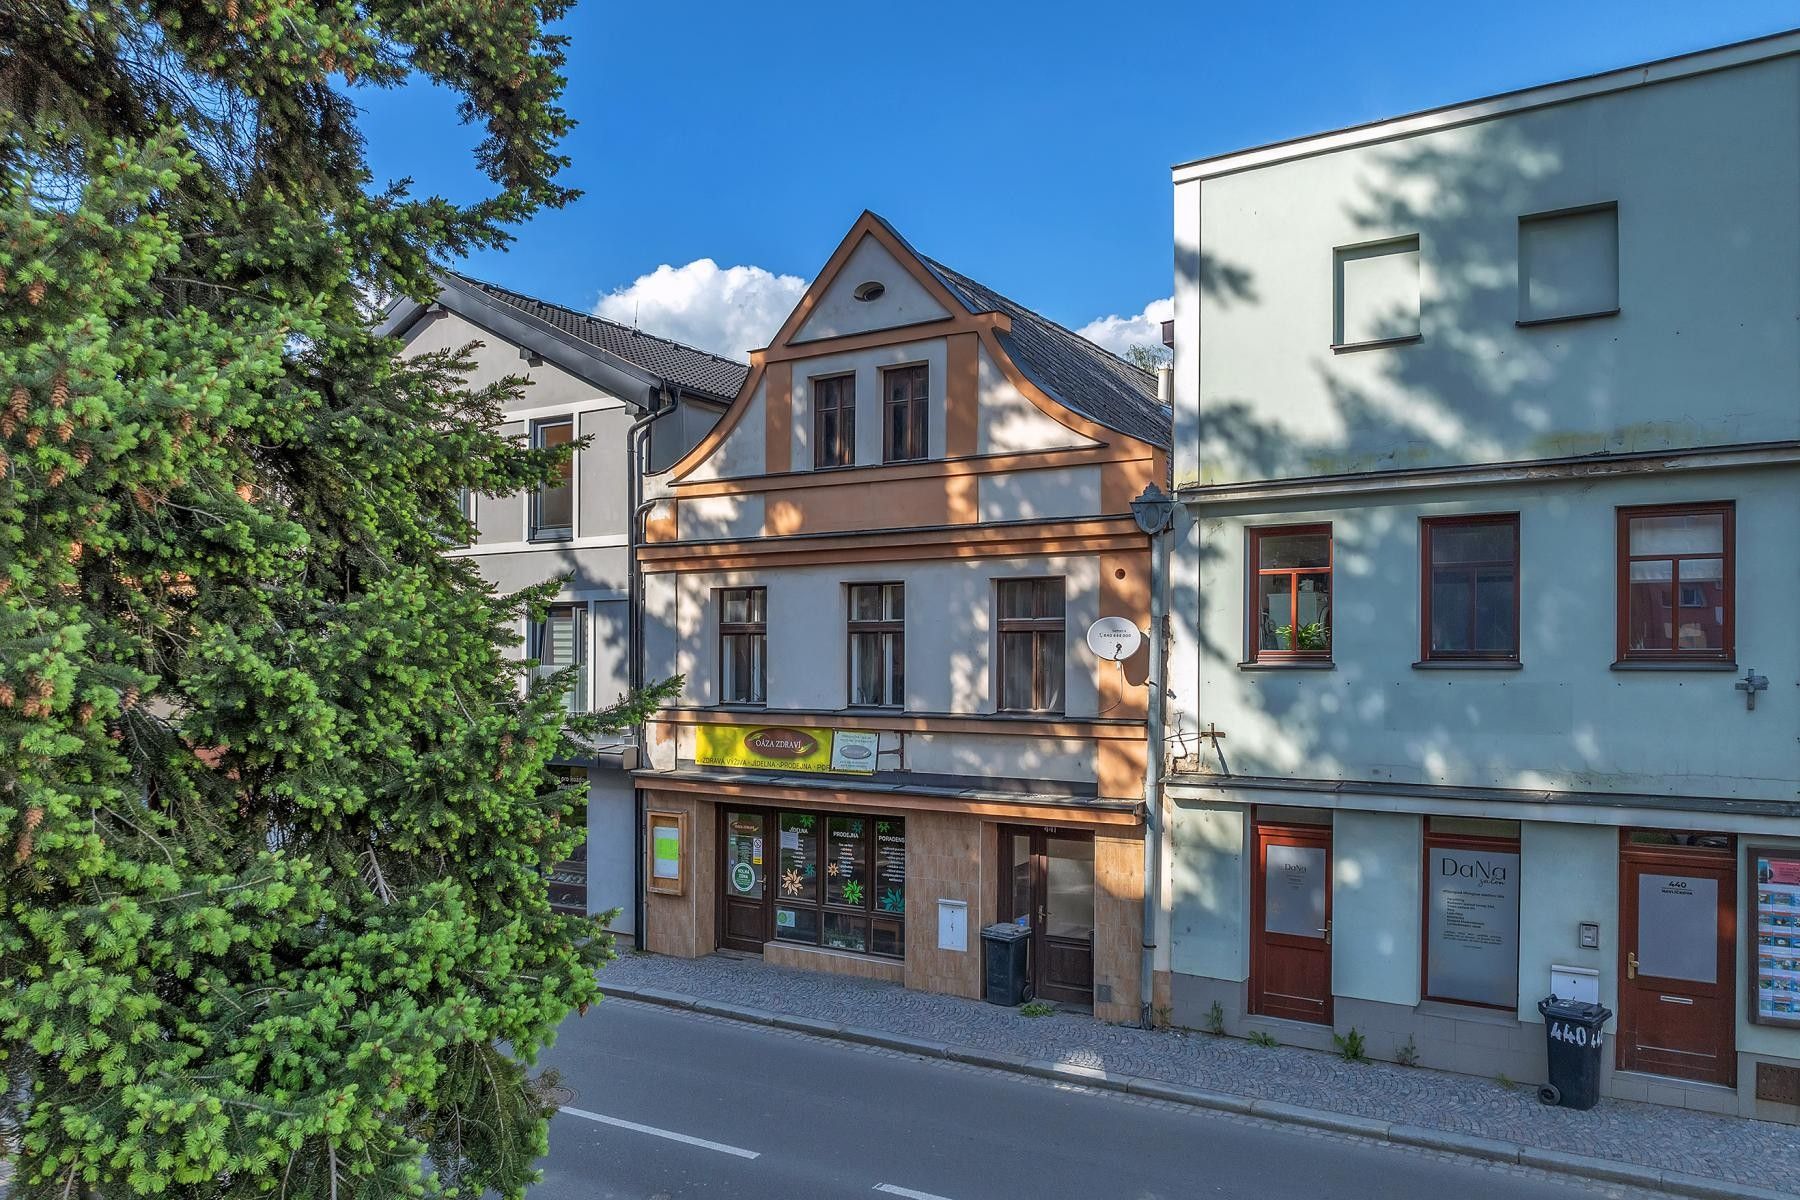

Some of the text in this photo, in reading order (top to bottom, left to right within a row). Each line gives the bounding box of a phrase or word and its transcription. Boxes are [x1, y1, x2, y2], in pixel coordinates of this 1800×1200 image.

[755, 738, 801, 749] OÁZA ZDRAVÍ
[702, 756, 725, 765] ZDRAVÁ
[726, 757, 747, 766] VÝŽIVA
[751, 760, 776, 768] JÍDELNA
[779, 761, 812, 770] PRODEJNA
[1442, 857, 1506, 881] DaNa
[1669, 880, 1687, 889] 440
[1550, 1022, 1587, 1047] 440
